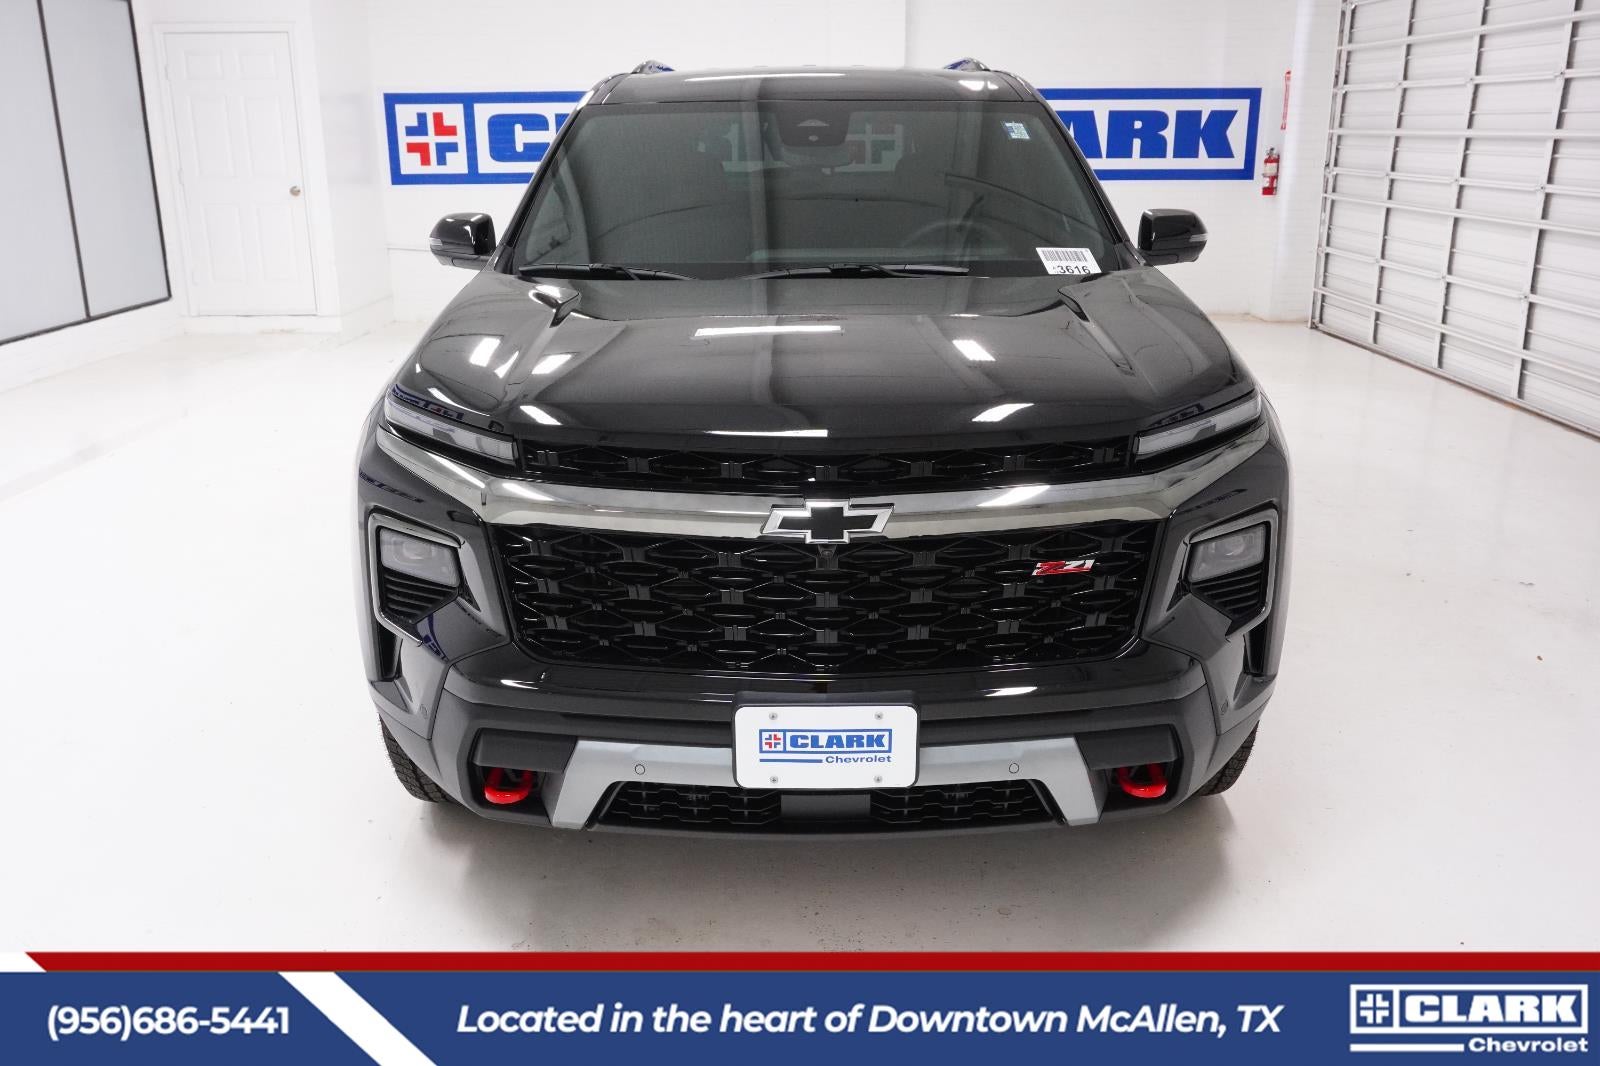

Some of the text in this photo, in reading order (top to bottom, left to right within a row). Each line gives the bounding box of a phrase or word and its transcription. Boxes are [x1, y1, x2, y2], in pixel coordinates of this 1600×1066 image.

[1055, 110, 1238, 158] ARK
[1032, 559, 1096, 576] Z71
[789, 734, 885, 749] CLARK
[825, 755, 892, 764] Chevrolet
